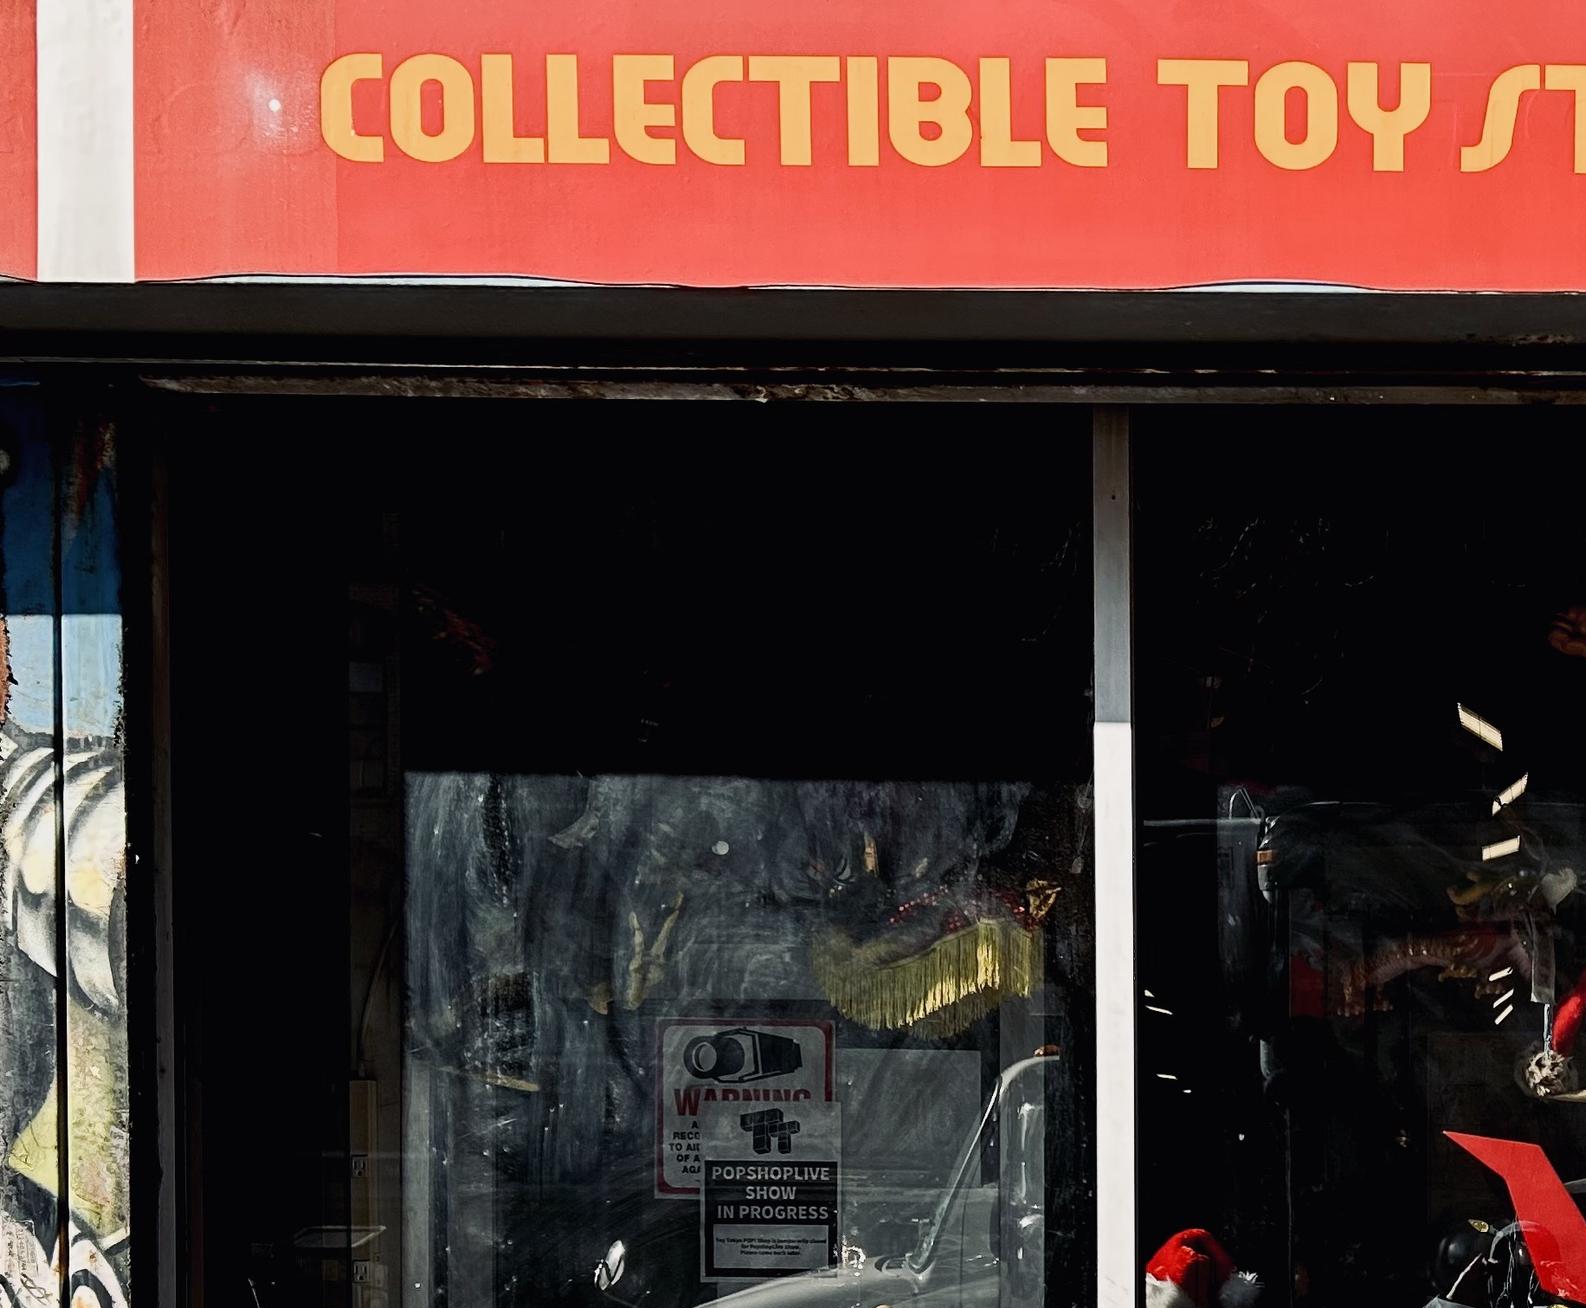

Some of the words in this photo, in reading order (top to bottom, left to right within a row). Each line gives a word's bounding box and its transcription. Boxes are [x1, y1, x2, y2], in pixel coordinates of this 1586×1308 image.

[320, 53, 1108, 168] COLLECTIBLE
[1157, 58, 1432, 172] TOY
[711, 1166, 831, 1182] POPSHOPLIVE
[745, 1186, 797, 1200] SHOW
[716, 1205, 734, 1219] IN
[739, 1205, 829, 1220] PROGRESS
